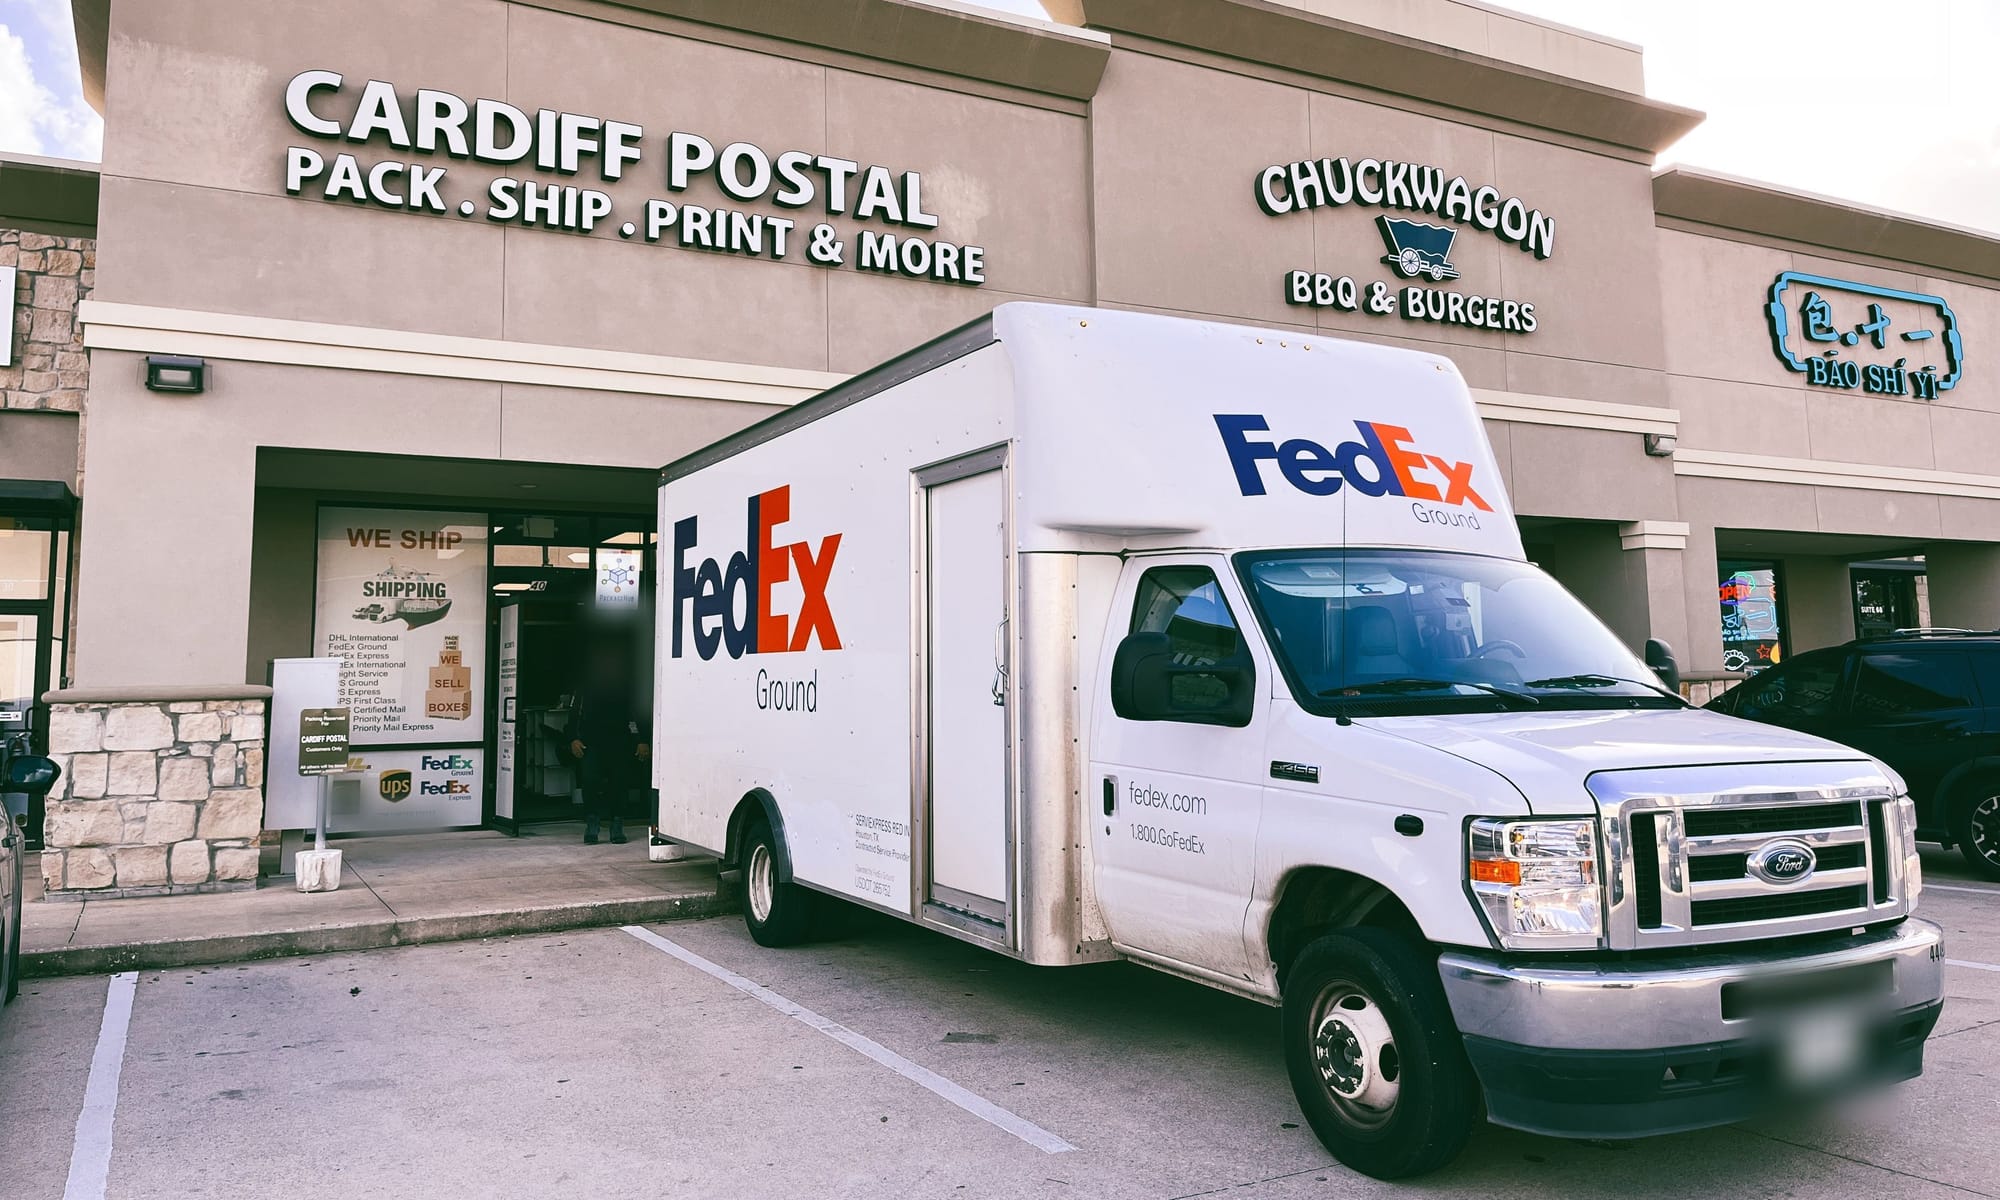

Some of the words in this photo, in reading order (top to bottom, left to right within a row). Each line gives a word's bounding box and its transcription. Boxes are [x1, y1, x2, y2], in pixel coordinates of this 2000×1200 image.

[285, 69, 643, 182] CARDIFF
[667, 131, 939, 229] POSTAL
[1257, 157, 1556, 260] CHUCKWAGON
[285, 147, 448, 214] PACK
[487, 178, 612, 232] SHIP
[647, 198, 795, 260] PRINT
[809, 223, 846, 267] &
[857, 230, 986, 284] MORE
[1288, 270, 1358, 311] BBQ
[1365, 281, 1397, 315] &
[1403, 287, 1538, 332] BURGERS
[1213, 414, 1496, 513] FedEx
[1412, 502, 1481, 530] Ground
[347, 528, 391, 548] WE
[400, 530, 463, 550] SHIP
[671, 484, 843, 661] FedEx
[363, 581, 446, 598] SHIPPING
[531, 581, 547, 591] 40
[328, 634, 347, 642] DHL
[350, 634, 399, 642] International
[328, 643, 355, 651] FedEx
[357, 643, 388, 651] Ground
[357, 652, 390, 661] Express
[440, 655, 460, 665] WE
[356, 661, 406, 669] International
[358, 670, 389, 678] Service
[348, 679, 379, 687] Ground
[434, 679, 465, 689] SELL
[348, 688, 381, 697] Express
[756, 668, 818, 713] Ground
[353, 697, 371, 705] First
[373, 697, 397, 705] Class
[353, 706, 387, 714] Certified
[389, 705, 407, 713] Mail
[428, 702, 469, 712] BOXES
[353, 715, 382, 723] Priority
[352, 724, 382, 733] Priority
[402, 723, 435, 732] Express
[301, 735, 325, 743] CARDIFF
[326, 734, 348, 742] POSTAL
[422, 755, 473, 770] FedEx
[451, 769, 474, 777] Ground
[381, 779, 410, 798] ups
[420, 780, 470, 795] FedEx
[1129, 781, 1207, 815] fedex.com
[1130, 823, 1206, 855] 1.800.GoFedEx
[1775, 854, 1804, 872] Ford
